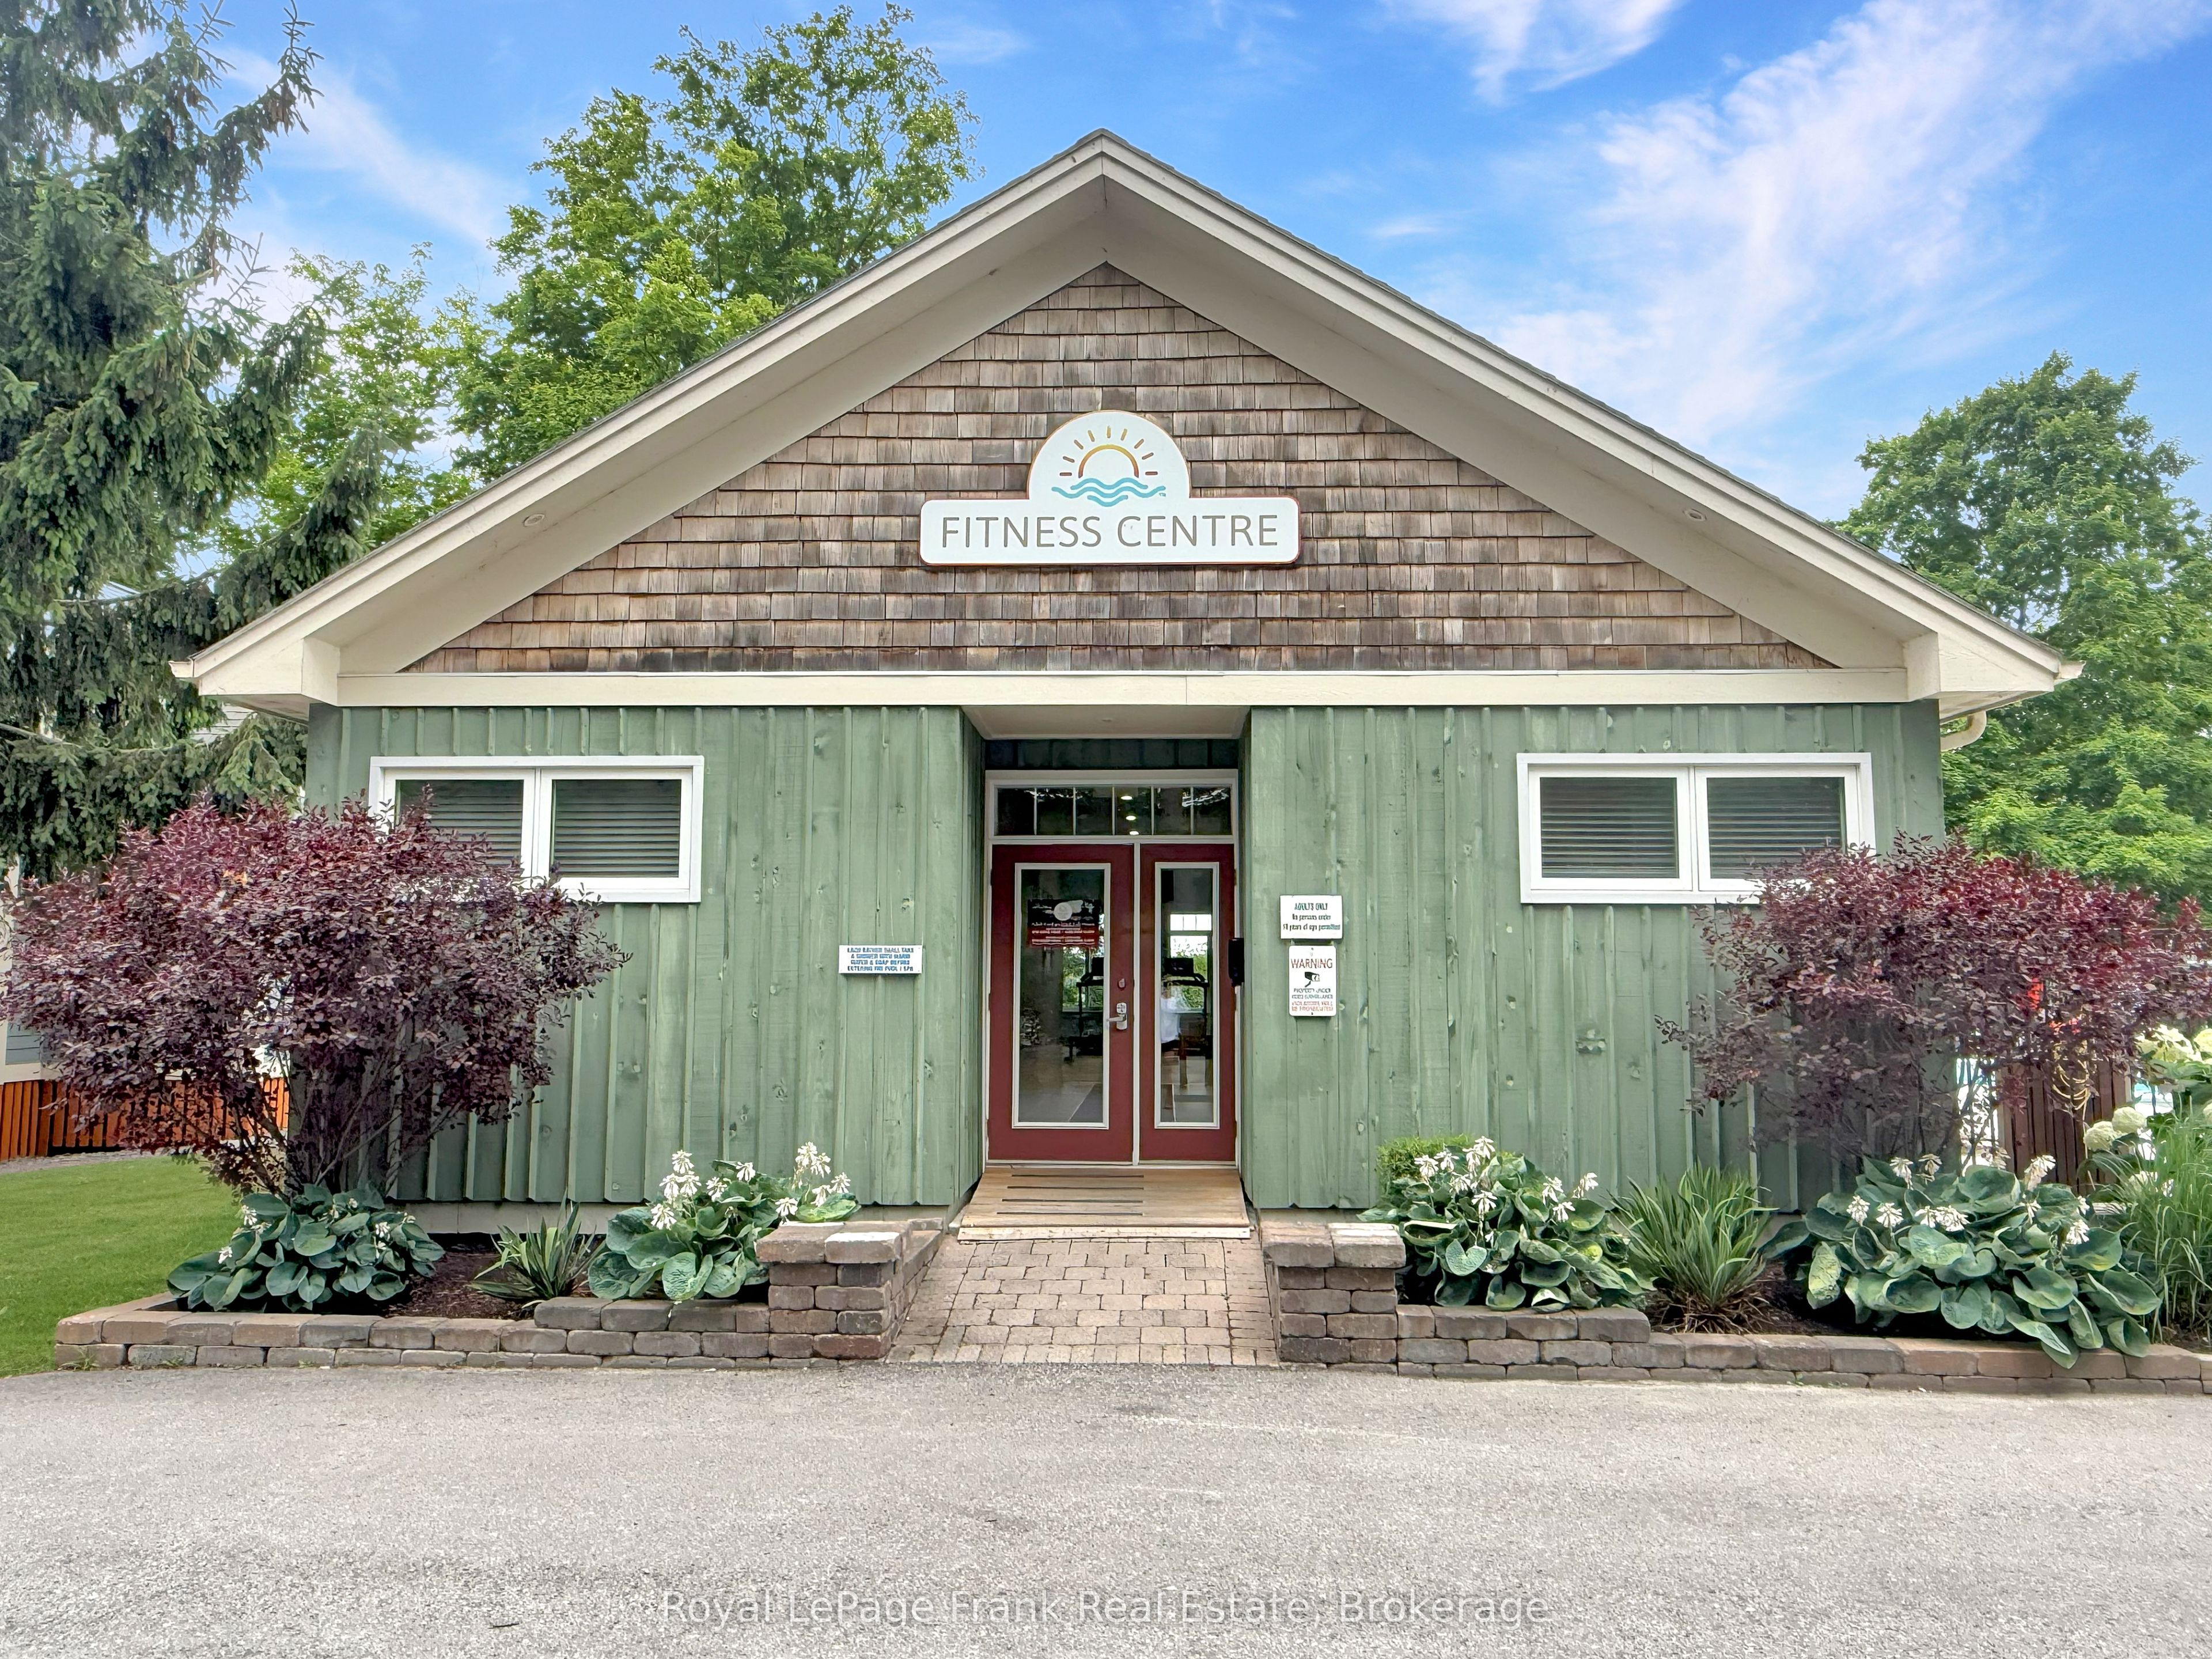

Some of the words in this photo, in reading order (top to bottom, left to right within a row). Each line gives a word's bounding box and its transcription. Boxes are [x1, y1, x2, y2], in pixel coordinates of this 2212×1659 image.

[942, 516, 1102, 548] FITNESS
[1117, 514, 1278, 548] CENTRE
[1294, 902, 1314, 911] ADULTS
[1316, 902, 1328, 910] ONLY
[1291, 959, 1333, 969] WARNING
